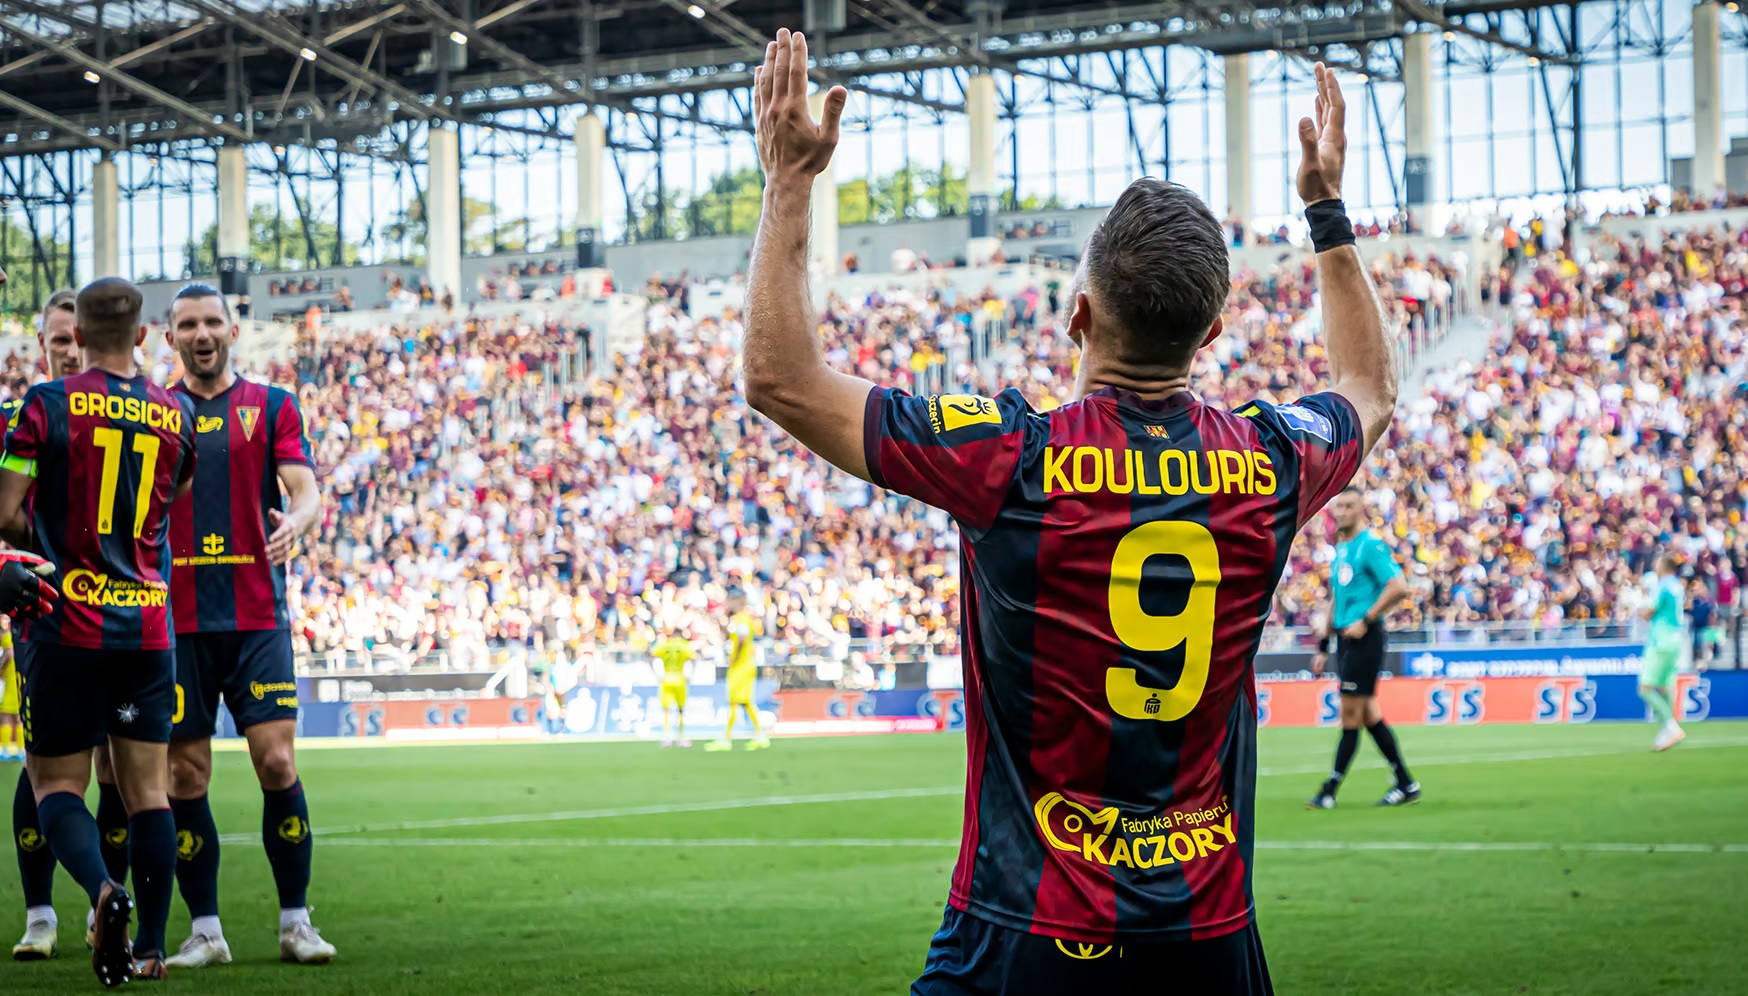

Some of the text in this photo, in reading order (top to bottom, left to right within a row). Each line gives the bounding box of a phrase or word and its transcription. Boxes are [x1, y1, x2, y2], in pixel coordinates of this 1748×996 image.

[69, 391, 182, 434] GROSICKI
[93, 426, 160, 539] 11
[1043, 446, 1277, 496] KOULOURIS
[1105, 520, 1222, 722] 9
[1427, 681, 1484, 723] STS
[1535, 677, 1596, 723] STS
[1083, 813, 1237, 869] KACZORY
[1121, 800, 1229, 835] Fabryka Papieru
